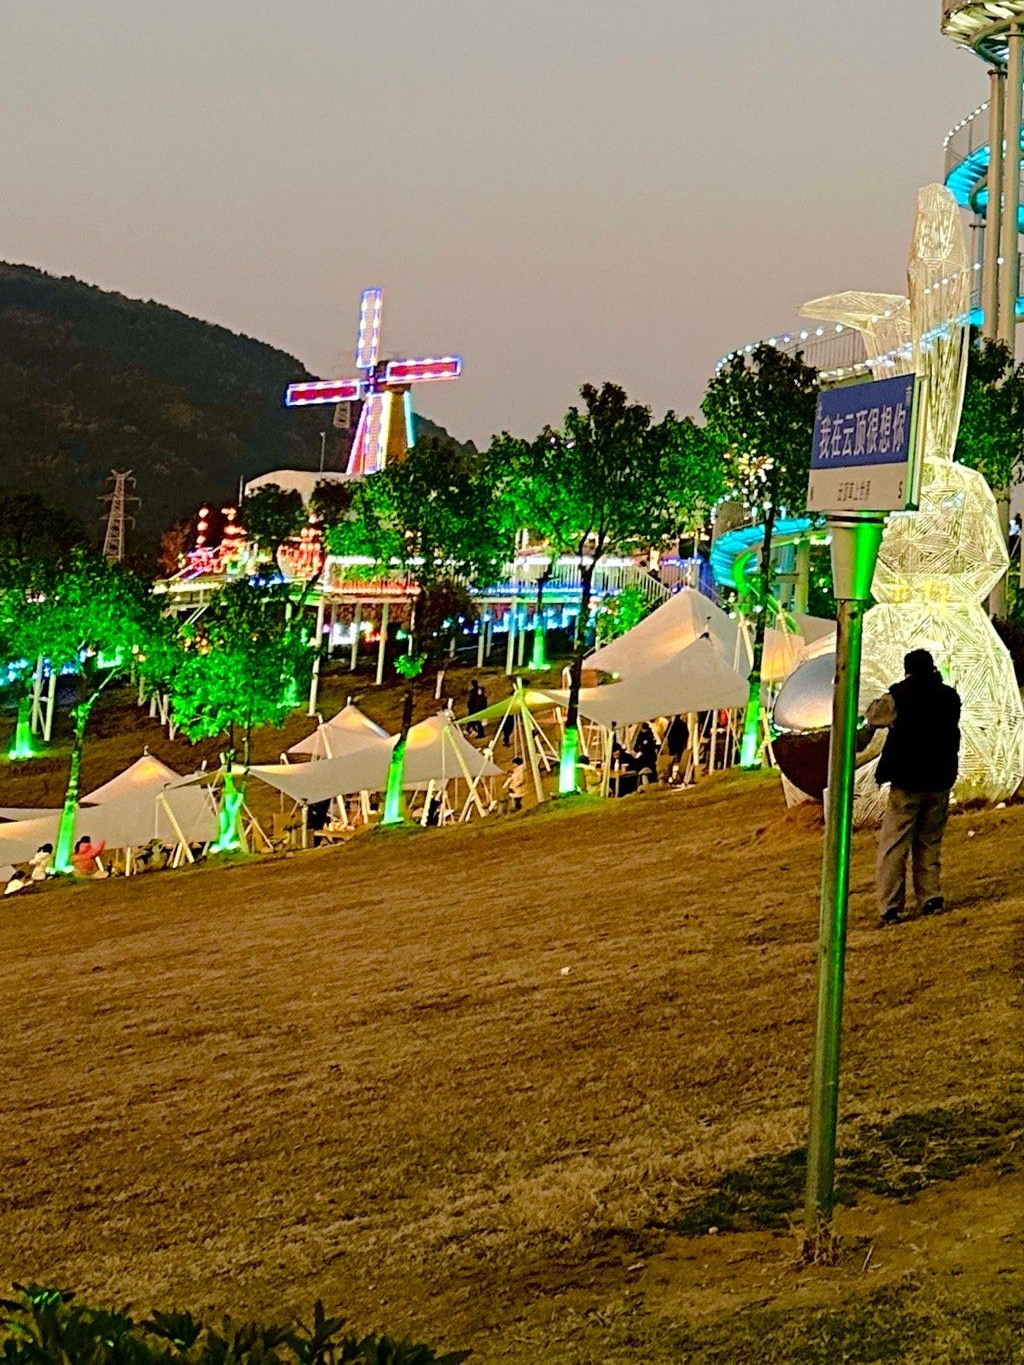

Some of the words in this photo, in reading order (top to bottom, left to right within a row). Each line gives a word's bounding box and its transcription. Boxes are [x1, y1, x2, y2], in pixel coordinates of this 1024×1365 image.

[819, 403, 907, 459] 我在云顶很想你
[898, 480, 903, 499] S
